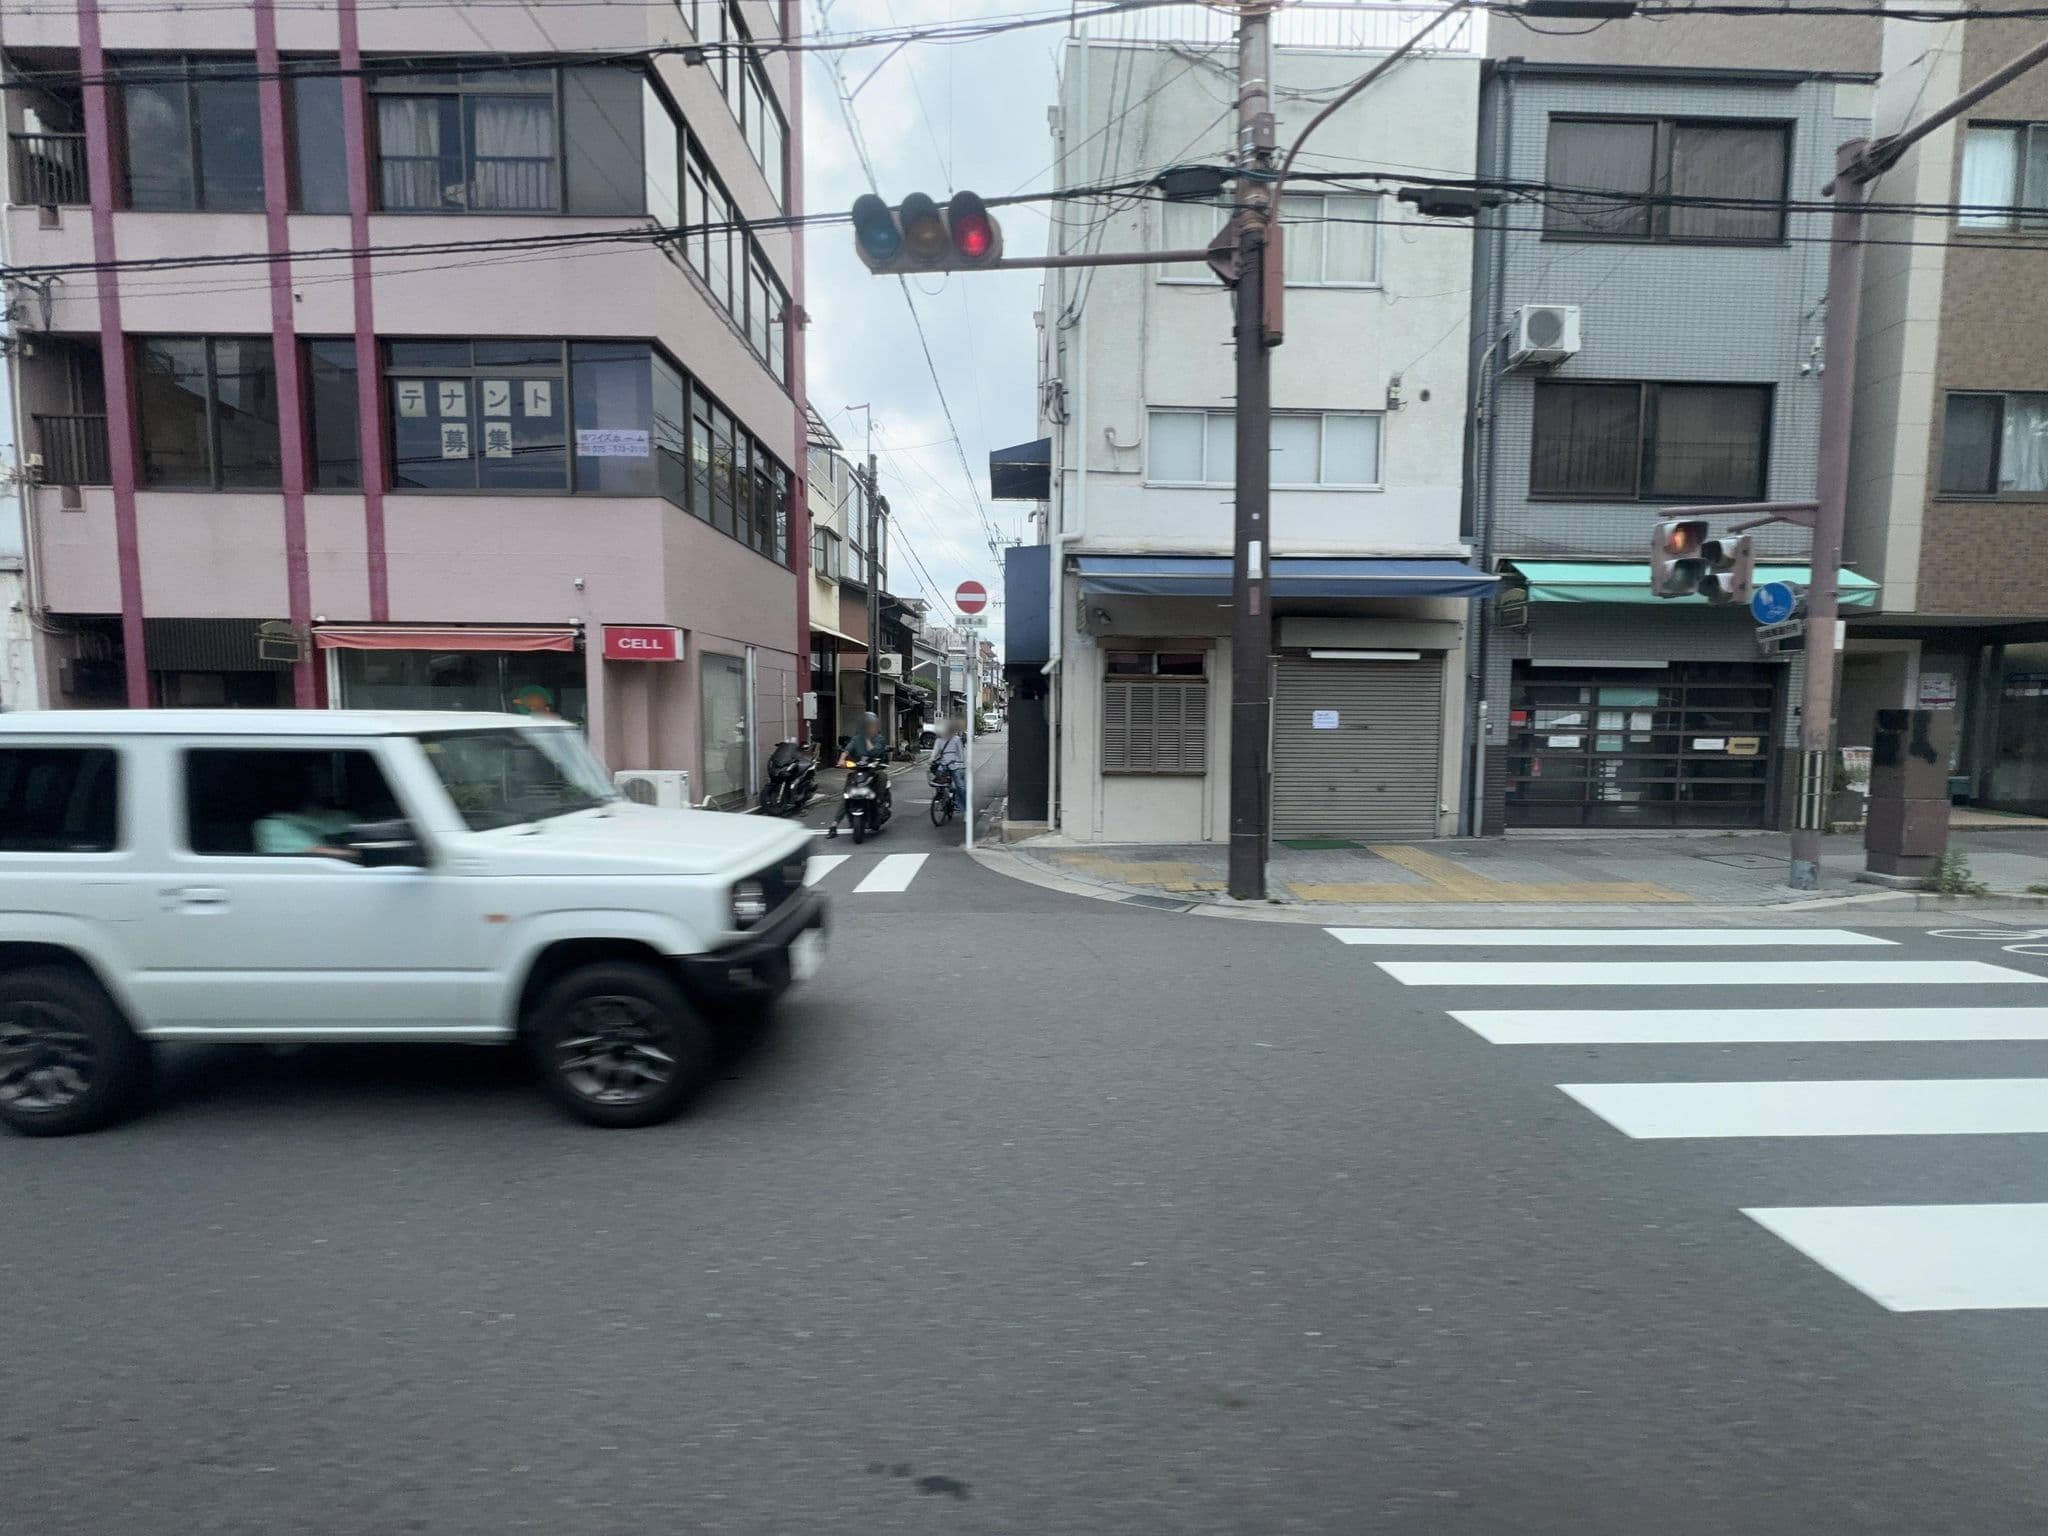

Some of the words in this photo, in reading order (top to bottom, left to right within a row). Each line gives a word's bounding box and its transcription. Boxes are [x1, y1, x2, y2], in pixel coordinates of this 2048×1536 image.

[401, 389, 548, 410] テナント
[444, 429, 510, 451] 募集
[618, 638, 664, 649] CELL
